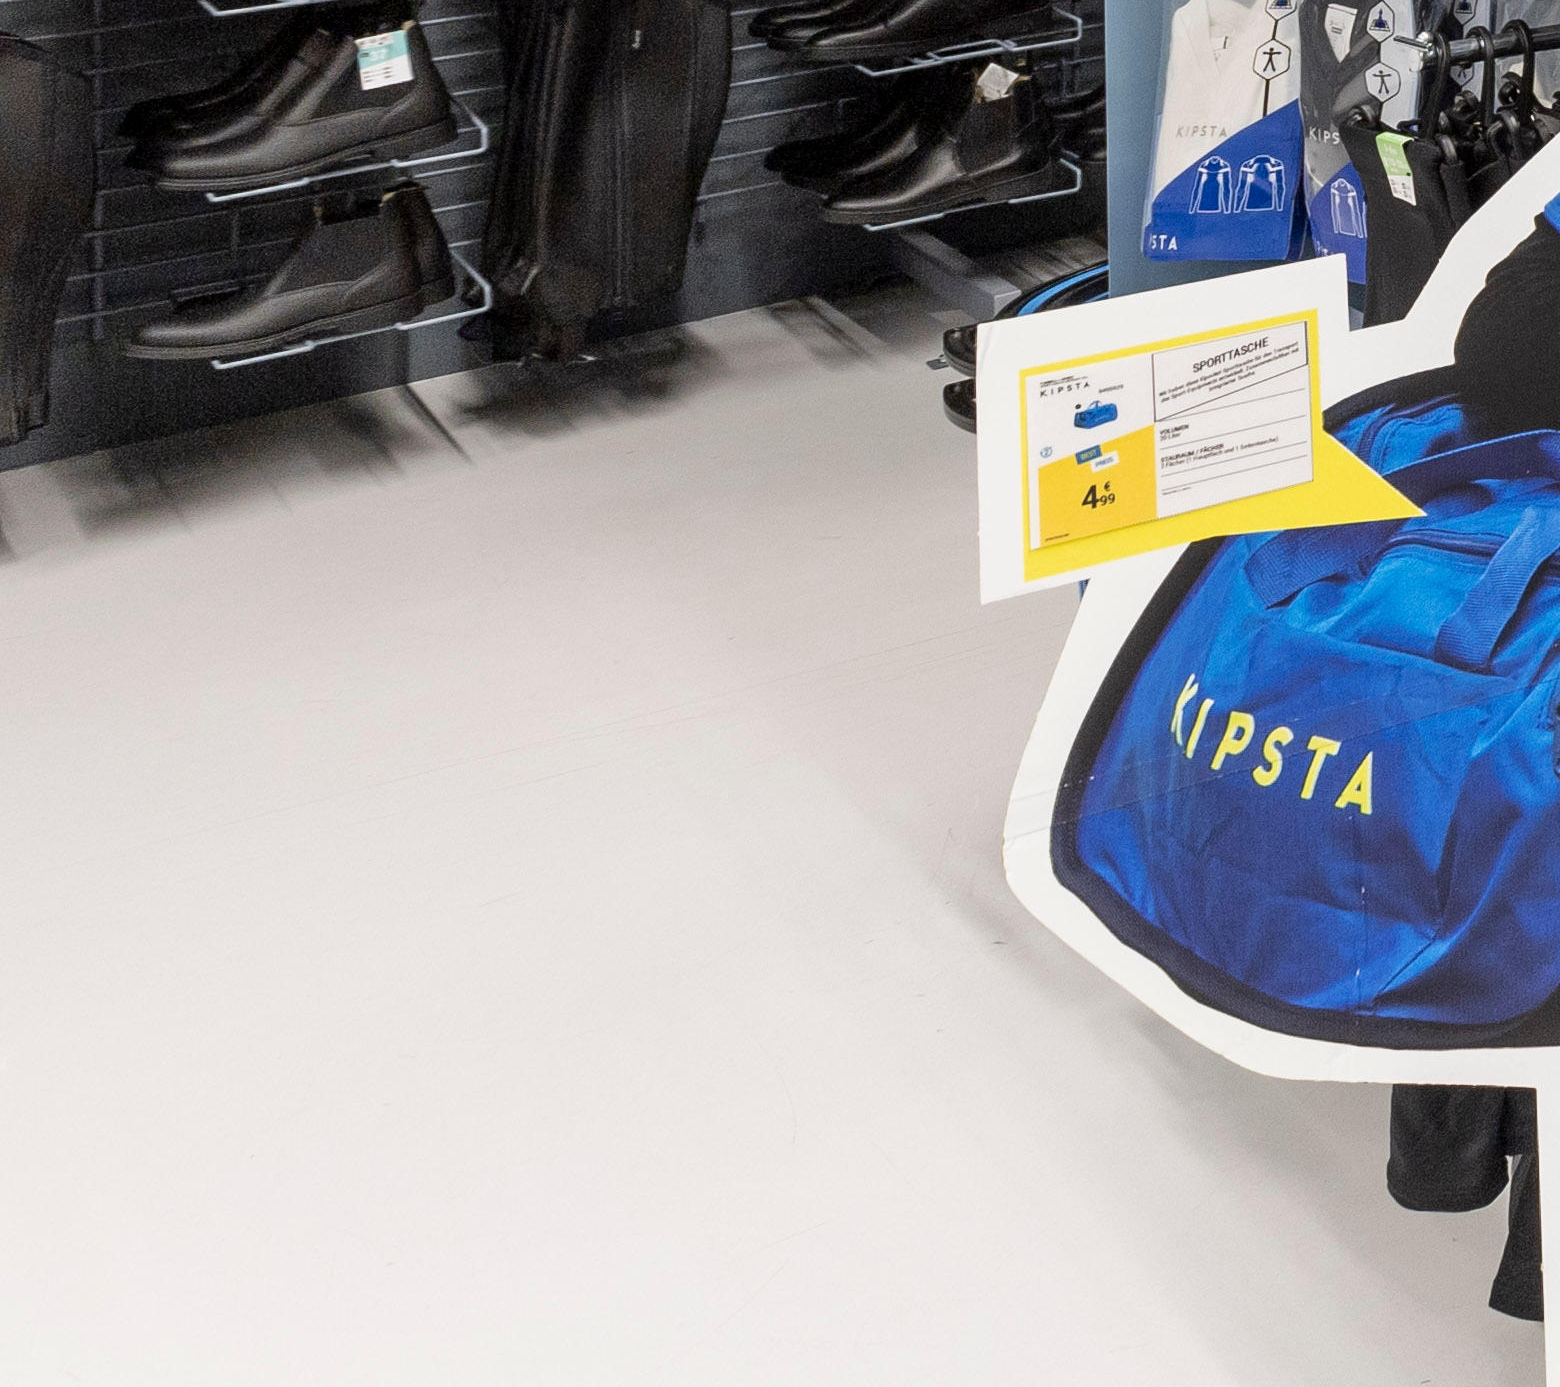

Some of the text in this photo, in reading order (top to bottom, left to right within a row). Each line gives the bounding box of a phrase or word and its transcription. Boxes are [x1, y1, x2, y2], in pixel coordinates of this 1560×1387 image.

[1175, 123, 1227, 139] KIPSTA
[1192, 336, 1269, 374] SPORTTASCHE
[1040, 382, 1090, 398] KIPSTA
[1081, 484, 1100, 509] 4
[1099, 492, 1116, 507] 99
[1169, 673, 1373, 815] KIPSTA
